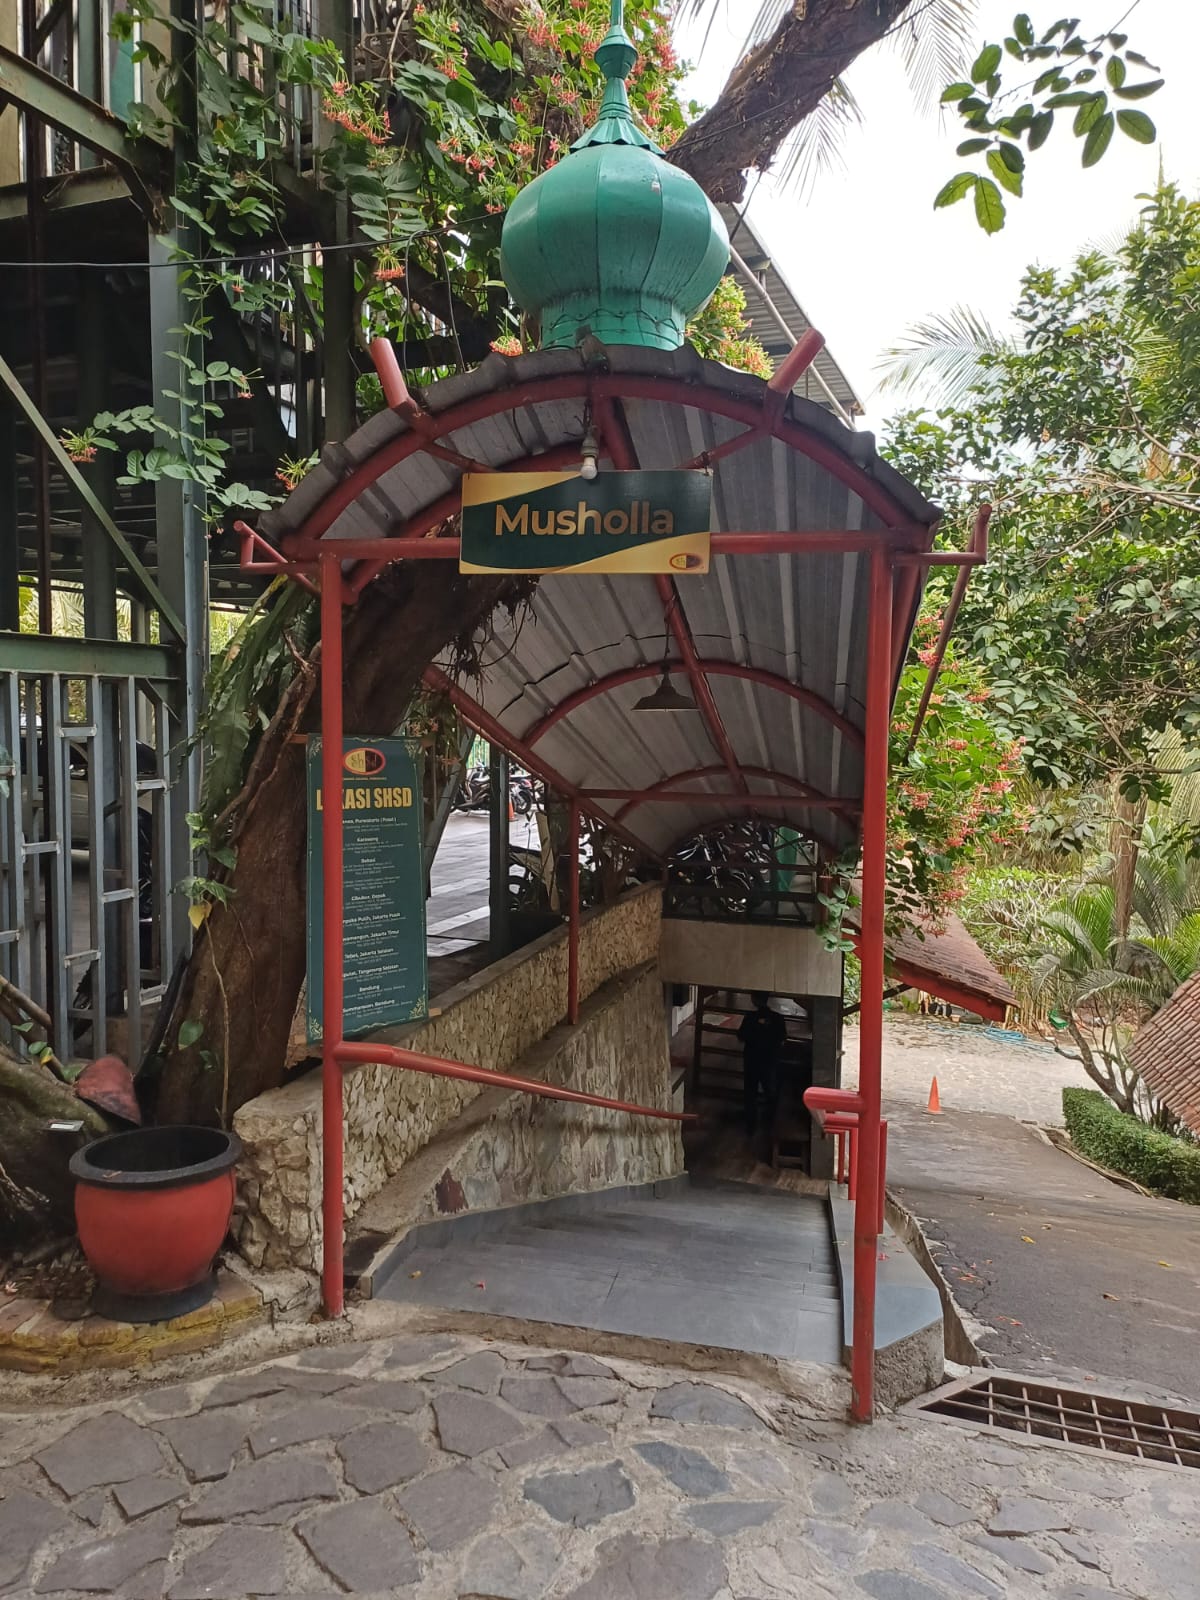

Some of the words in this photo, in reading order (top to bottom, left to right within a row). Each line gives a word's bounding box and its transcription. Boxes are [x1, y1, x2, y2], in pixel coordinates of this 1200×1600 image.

[495, 501, 674, 536] Musholla
[316, 788, 371, 811] LASI
[373, 787, 412, 808] SHSD
